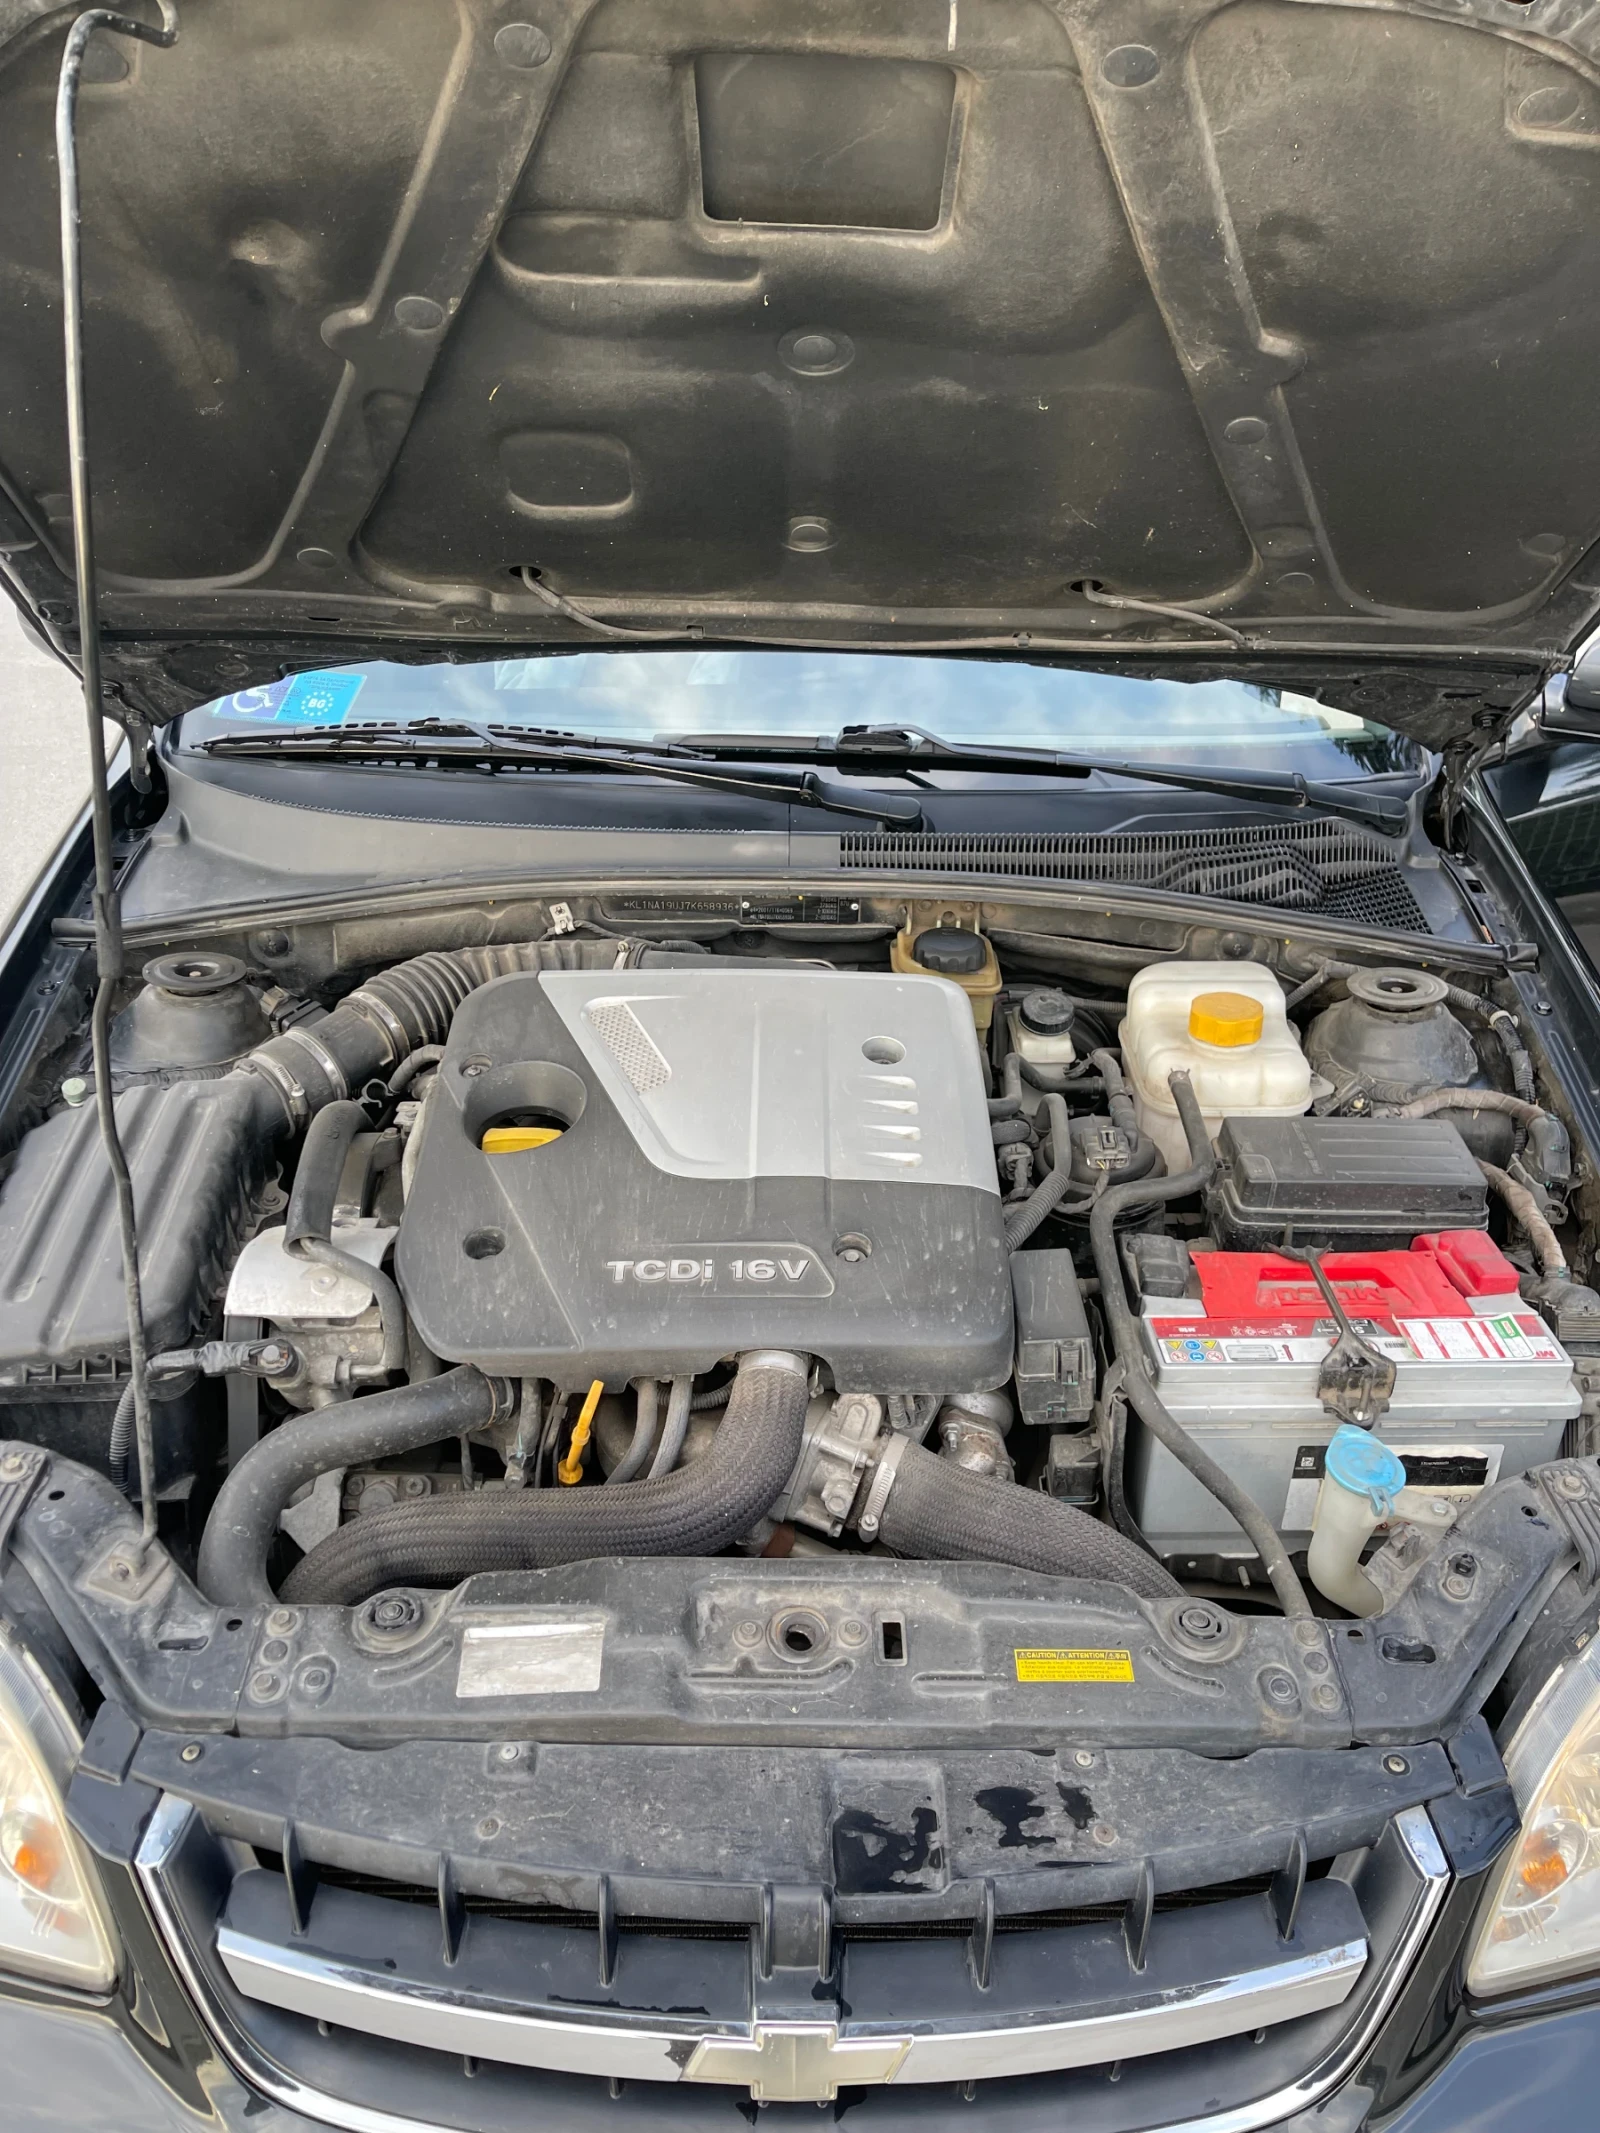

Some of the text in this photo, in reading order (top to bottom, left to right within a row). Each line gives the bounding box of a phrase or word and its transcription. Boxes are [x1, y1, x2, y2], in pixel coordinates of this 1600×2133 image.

[308, 698, 327, 709] BG
[605, 1259, 811, 1281] TCDi 16V
